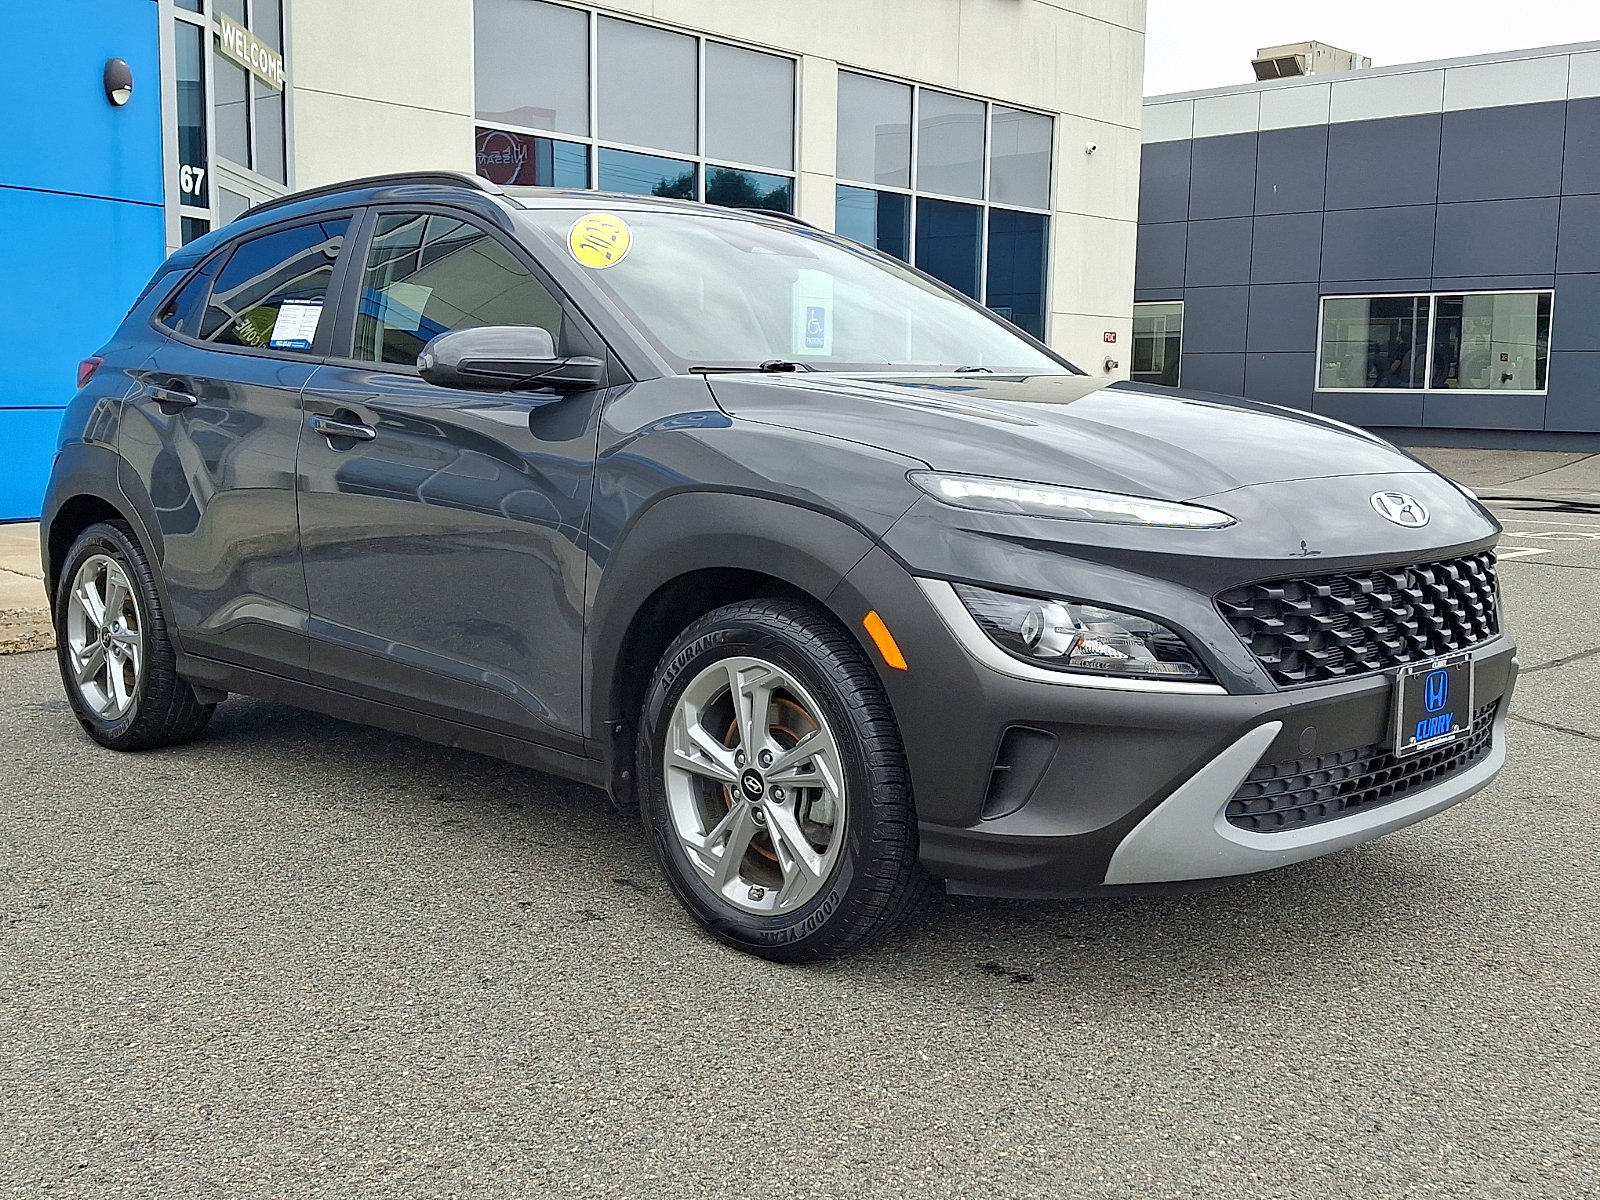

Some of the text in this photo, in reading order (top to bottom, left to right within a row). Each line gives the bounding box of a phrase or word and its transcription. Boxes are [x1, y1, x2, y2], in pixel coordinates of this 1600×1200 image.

[221, 18, 283, 84] WELCOME
[178, 164, 205, 195] 67
[1104, 332, 1116, 342] FDC
[661, 631, 729, 692] ASSURANCE
[1416, 712, 1453, 740] CURRY
[761, 890, 840, 942] GOODYEAR
